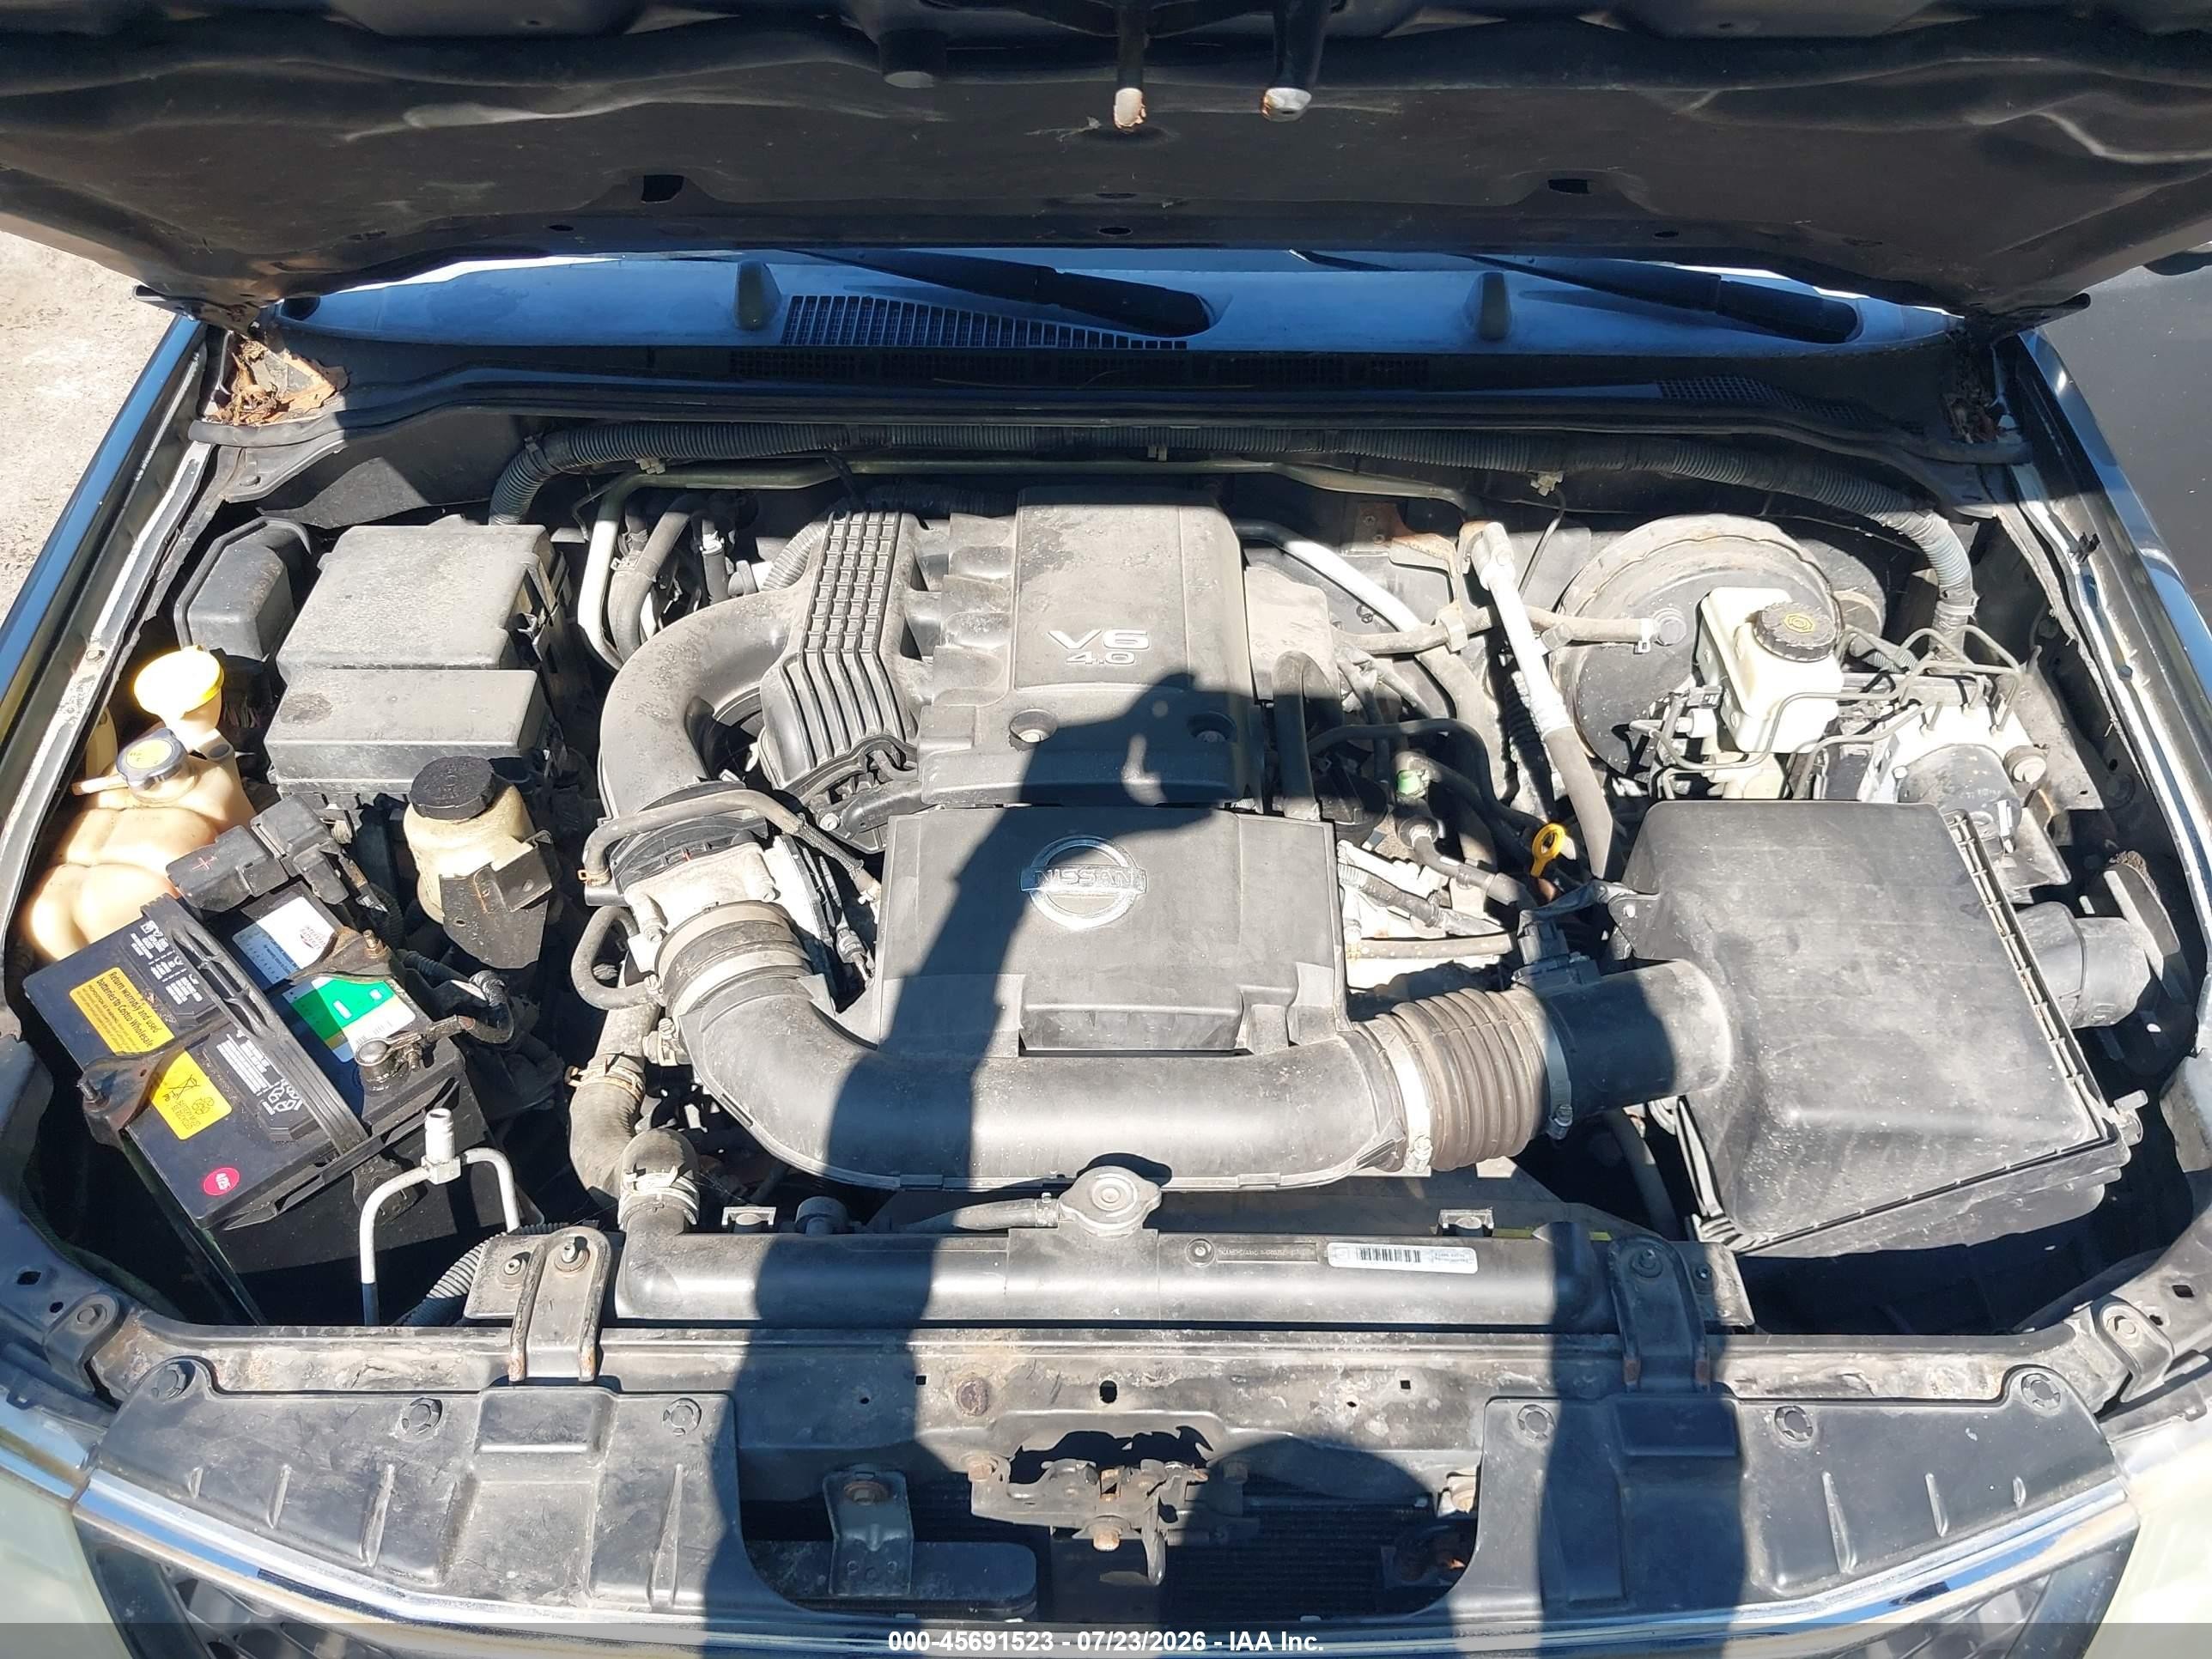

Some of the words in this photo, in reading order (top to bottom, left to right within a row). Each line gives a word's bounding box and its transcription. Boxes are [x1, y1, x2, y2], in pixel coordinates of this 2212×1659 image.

[1047, 628, 1150, 650] V6
[1066, 651, 1135, 665] 4.0
[1034, 867, 1133, 888] NISSAN
[95, 976, 118, 1000] batteries
[112, 998, 122, 1007] to
[117, 1003, 133, 1022] Costco
[129, 1018, 155, 1048] Wholesale
[108, 971, 125, 990] Return
[137, 1008, 152, 1020] and
[145, 1018, 162, 1033] used
